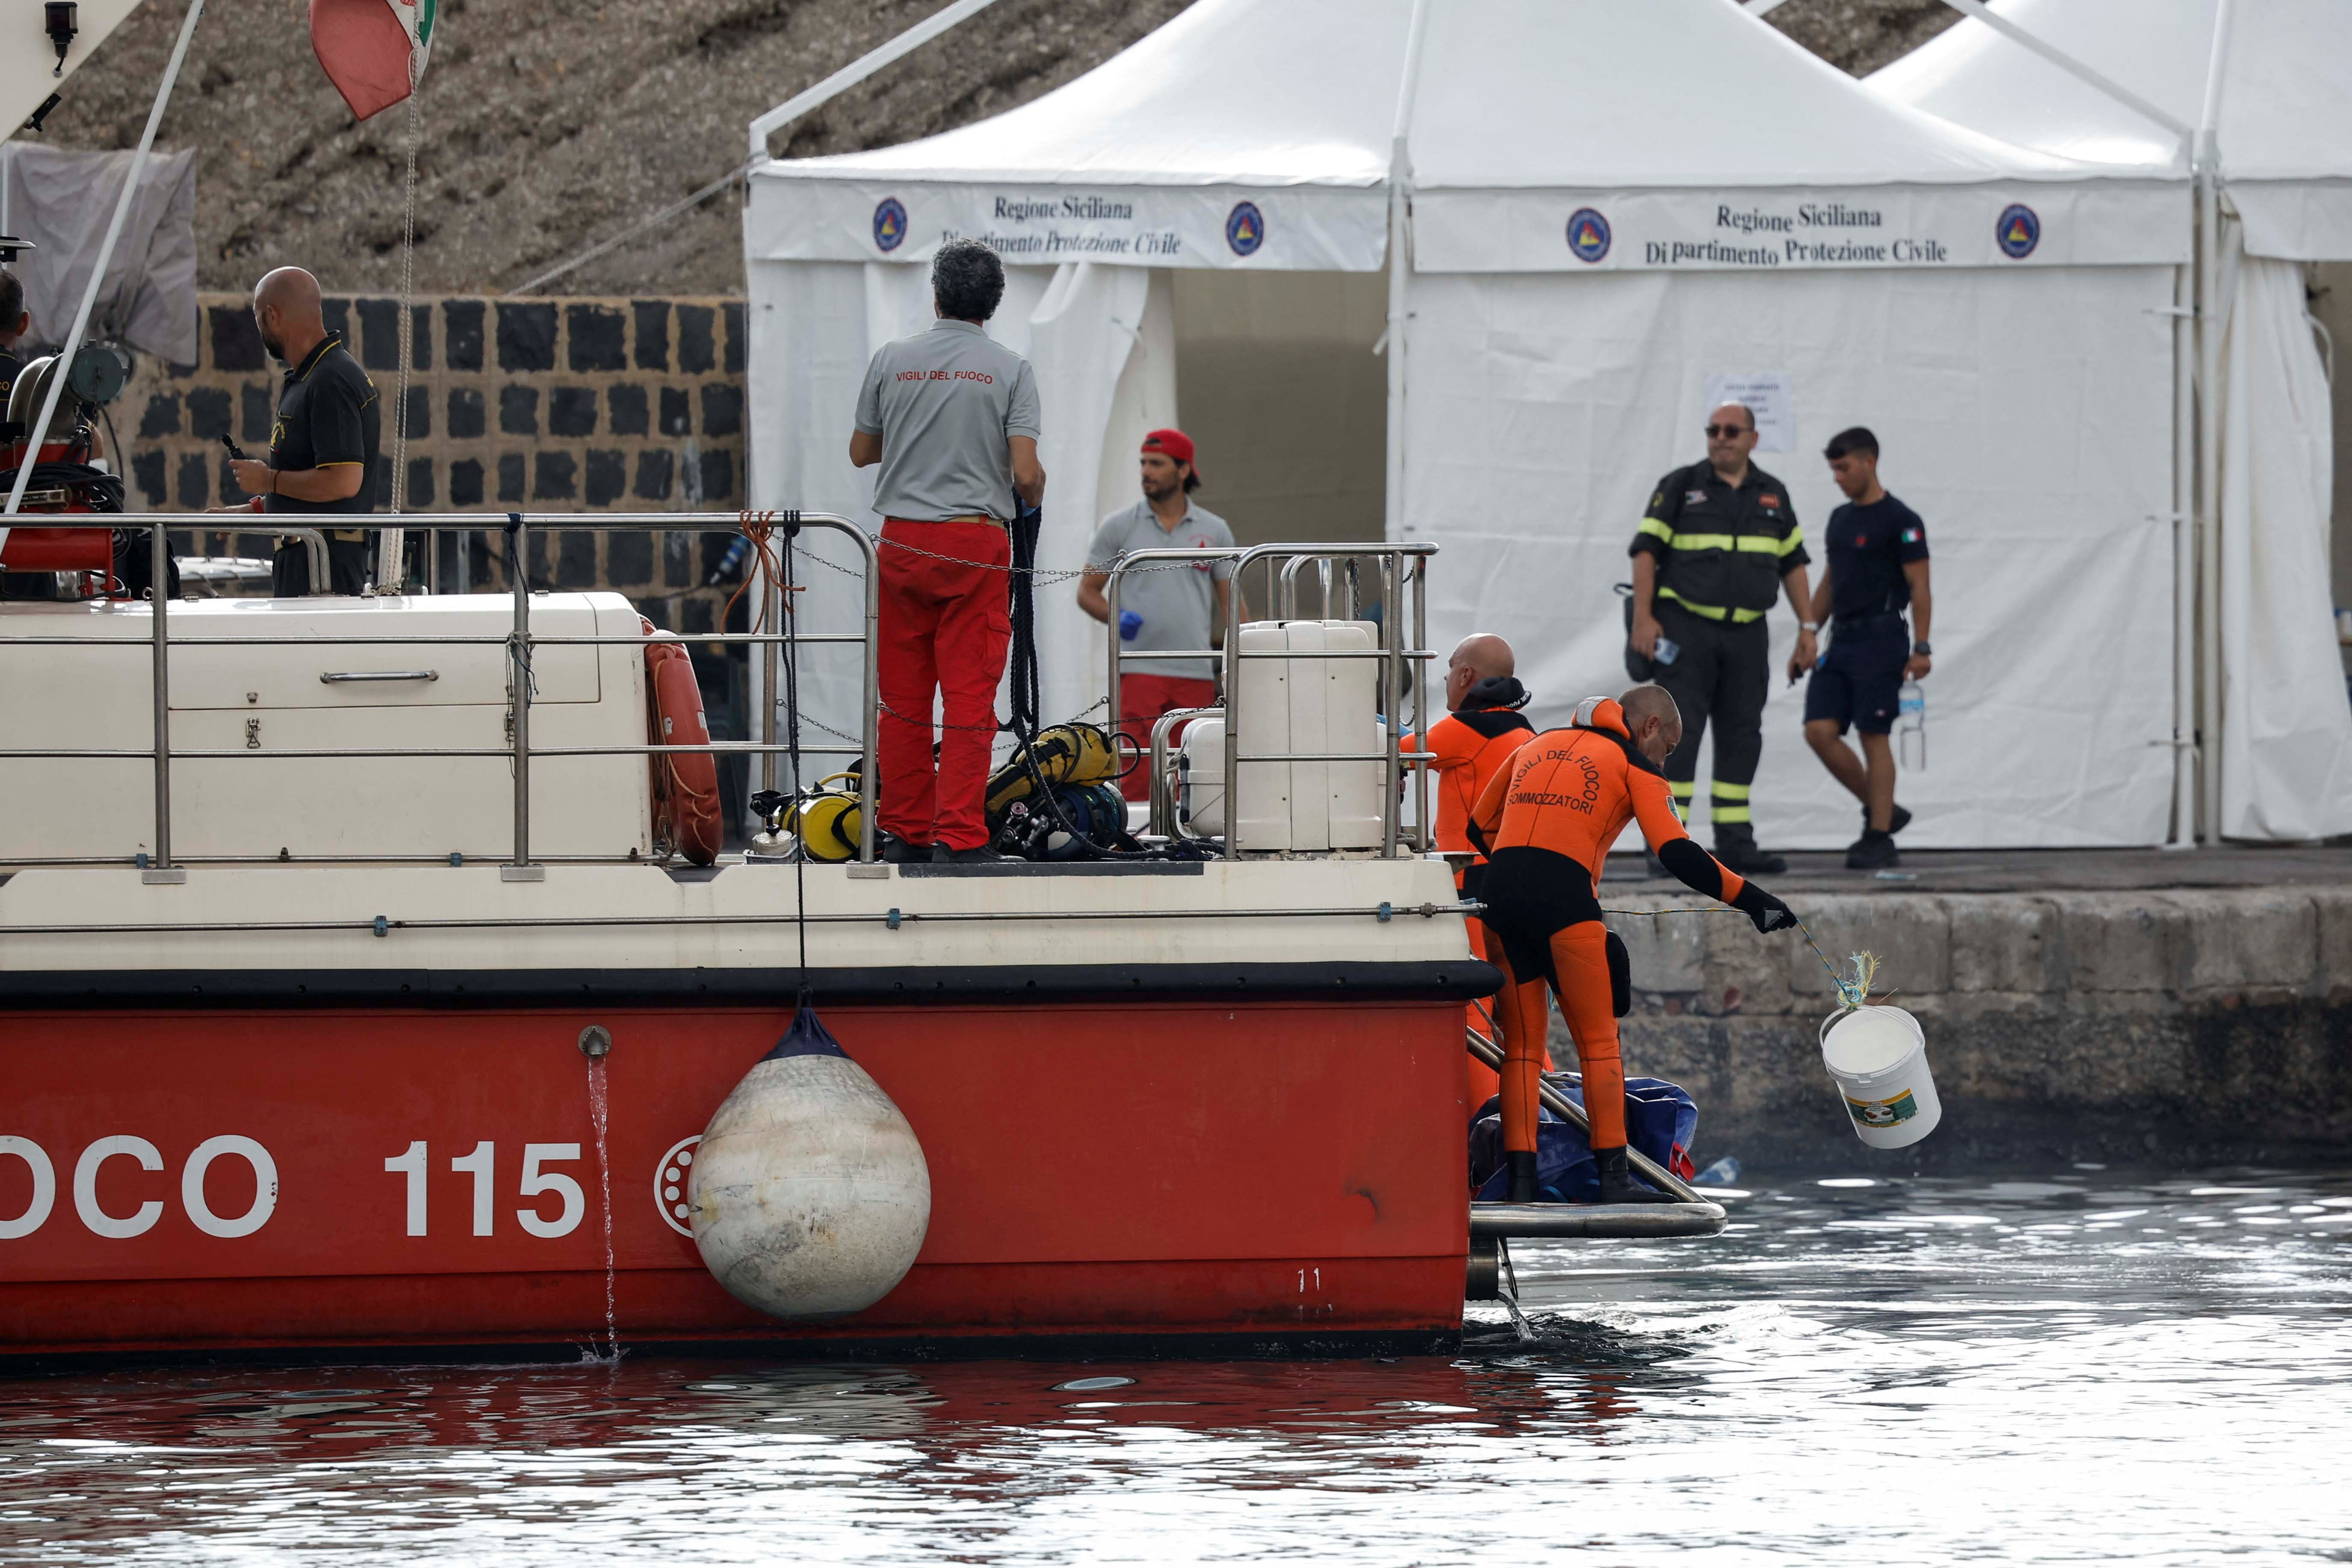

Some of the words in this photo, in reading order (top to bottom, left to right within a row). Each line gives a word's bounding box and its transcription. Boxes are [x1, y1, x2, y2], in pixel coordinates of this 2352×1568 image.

[995, 196, 1058, 224] Regione
[1061, 195, 1132, 219] Siciliana
[1716, 204, 1794, 235] Regione
[1798, 204, 1882, 227] Siciliana
[1046, 230, 1130, 254] Protezione
[1135, 232, 1181, 254] Civile
[1785, 239, 1886, 262] Protezione
[1892, 239, 1947, 262] Civile
[896, 371, 927, 382] VIGILI
[929, 370, 951, 380] DEL
[954, 371, 993, 384] FUOCO
[1510, 754, 1542, 791] VIGILI
[1546, 750, 1574, 761] DEL
[1575, 756, 1600, 801] FUOCO
[1507, 792, 1593, 815] SOMMOZZATORI
[385, 1141, 584, 1238] 115
